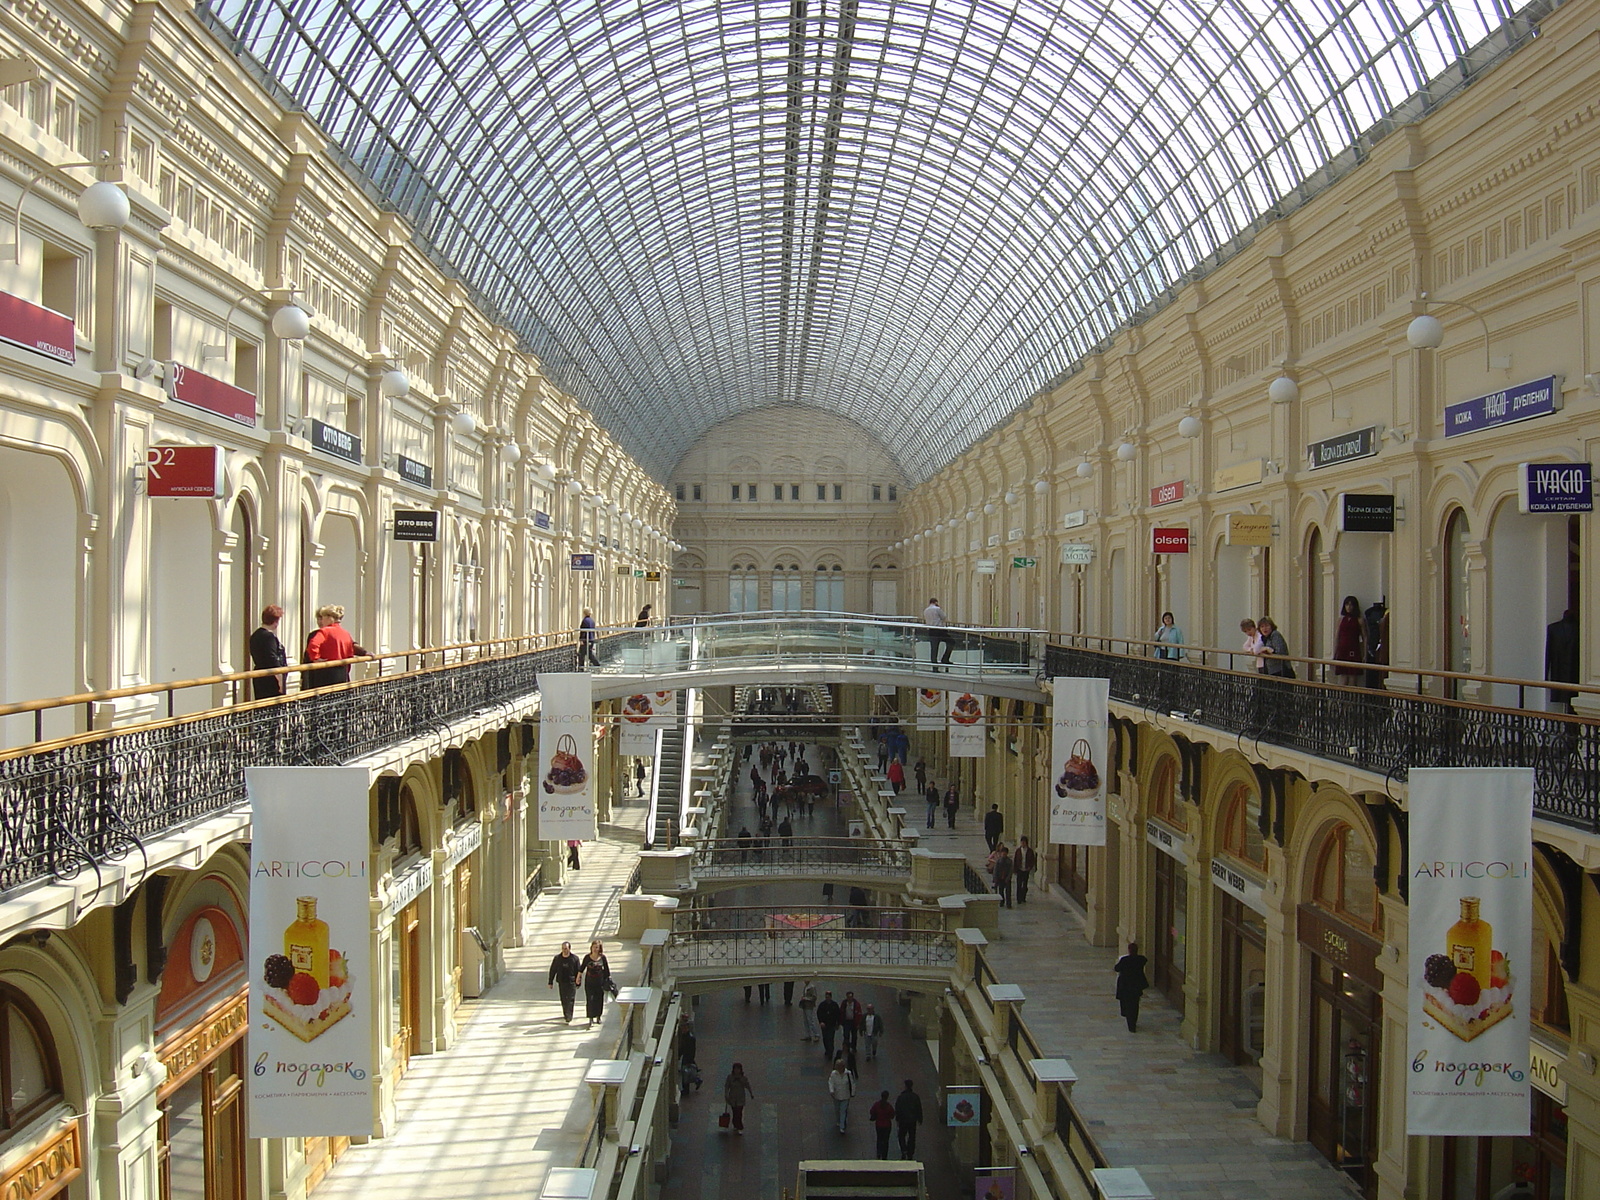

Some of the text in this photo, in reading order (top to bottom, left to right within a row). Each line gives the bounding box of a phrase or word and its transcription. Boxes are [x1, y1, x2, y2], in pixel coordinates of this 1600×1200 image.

[1455, 388, 1550, 425] КОЖА IVAGIO ДУБЛЕНКИ
[323, 425, 352, 452] OTTO BERG
[1321, 443, 1336, 462] REGINA
[1535, 469, 1584, 494] IVAGIO
[1158, 486, 1176, 503] olsen
[1530, 503, 1550, 511] КОЖА
[1557, 503, 1592, 511] ДУБЛЕНКИ
[1155, 535, 1187, 545] olsen
[1065, 553, 1089, 561] МОДА
[542, 714, 590, 724] ARTICOLI
[255, 860, 365, 878] ARTICOLI
[1211, 860, 1245, 893] GERRY WEBER
[1414, 861, 1527, 879] ARTICOLI
[202, 1000, 247, 1055] LONDON
[254, 1051, 366, 1087] в подарок
[1412, 1049, 1524, 1088] в подарок
[1530, 1055, 1558, 1088] ANO
